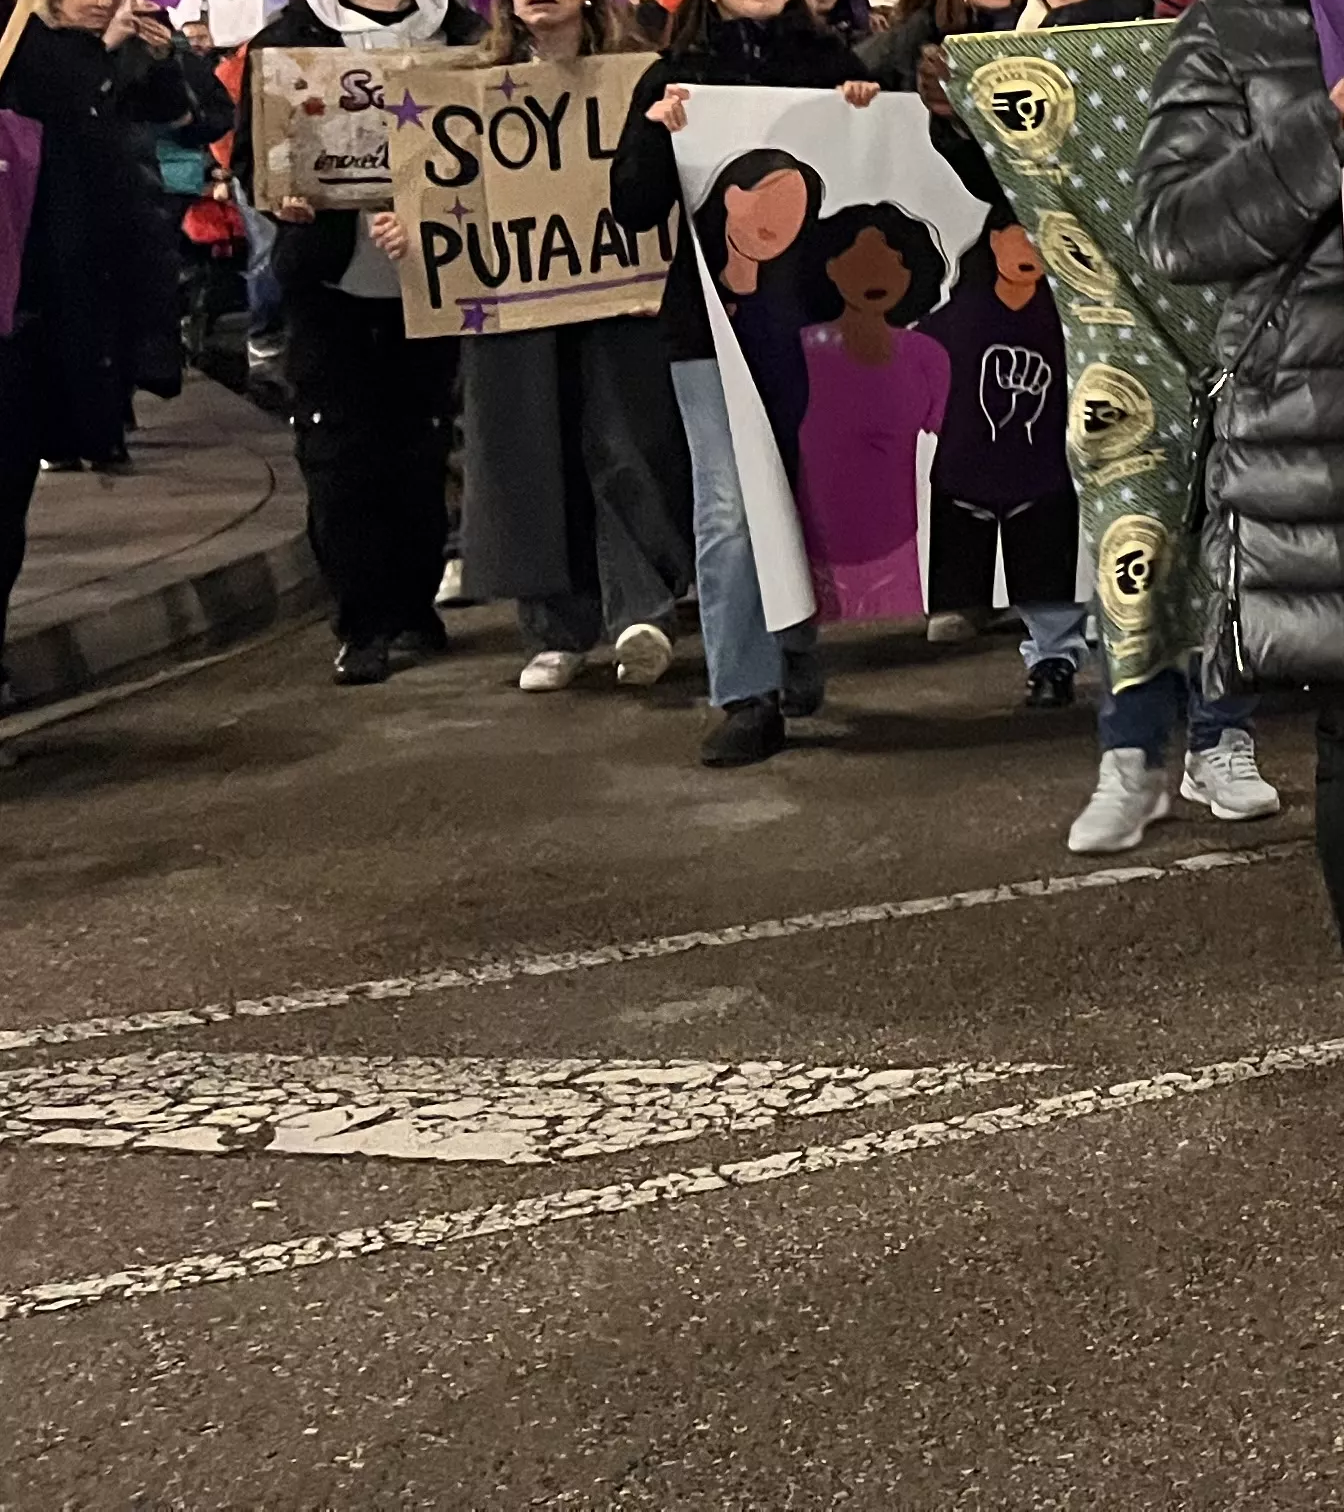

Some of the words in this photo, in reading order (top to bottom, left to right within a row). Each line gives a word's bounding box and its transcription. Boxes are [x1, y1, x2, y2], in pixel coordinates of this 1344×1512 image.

[425, 91, 570, 188] SOY
[586, 96, 618, 160] L
[420, 213, 582, 309] PUTA
